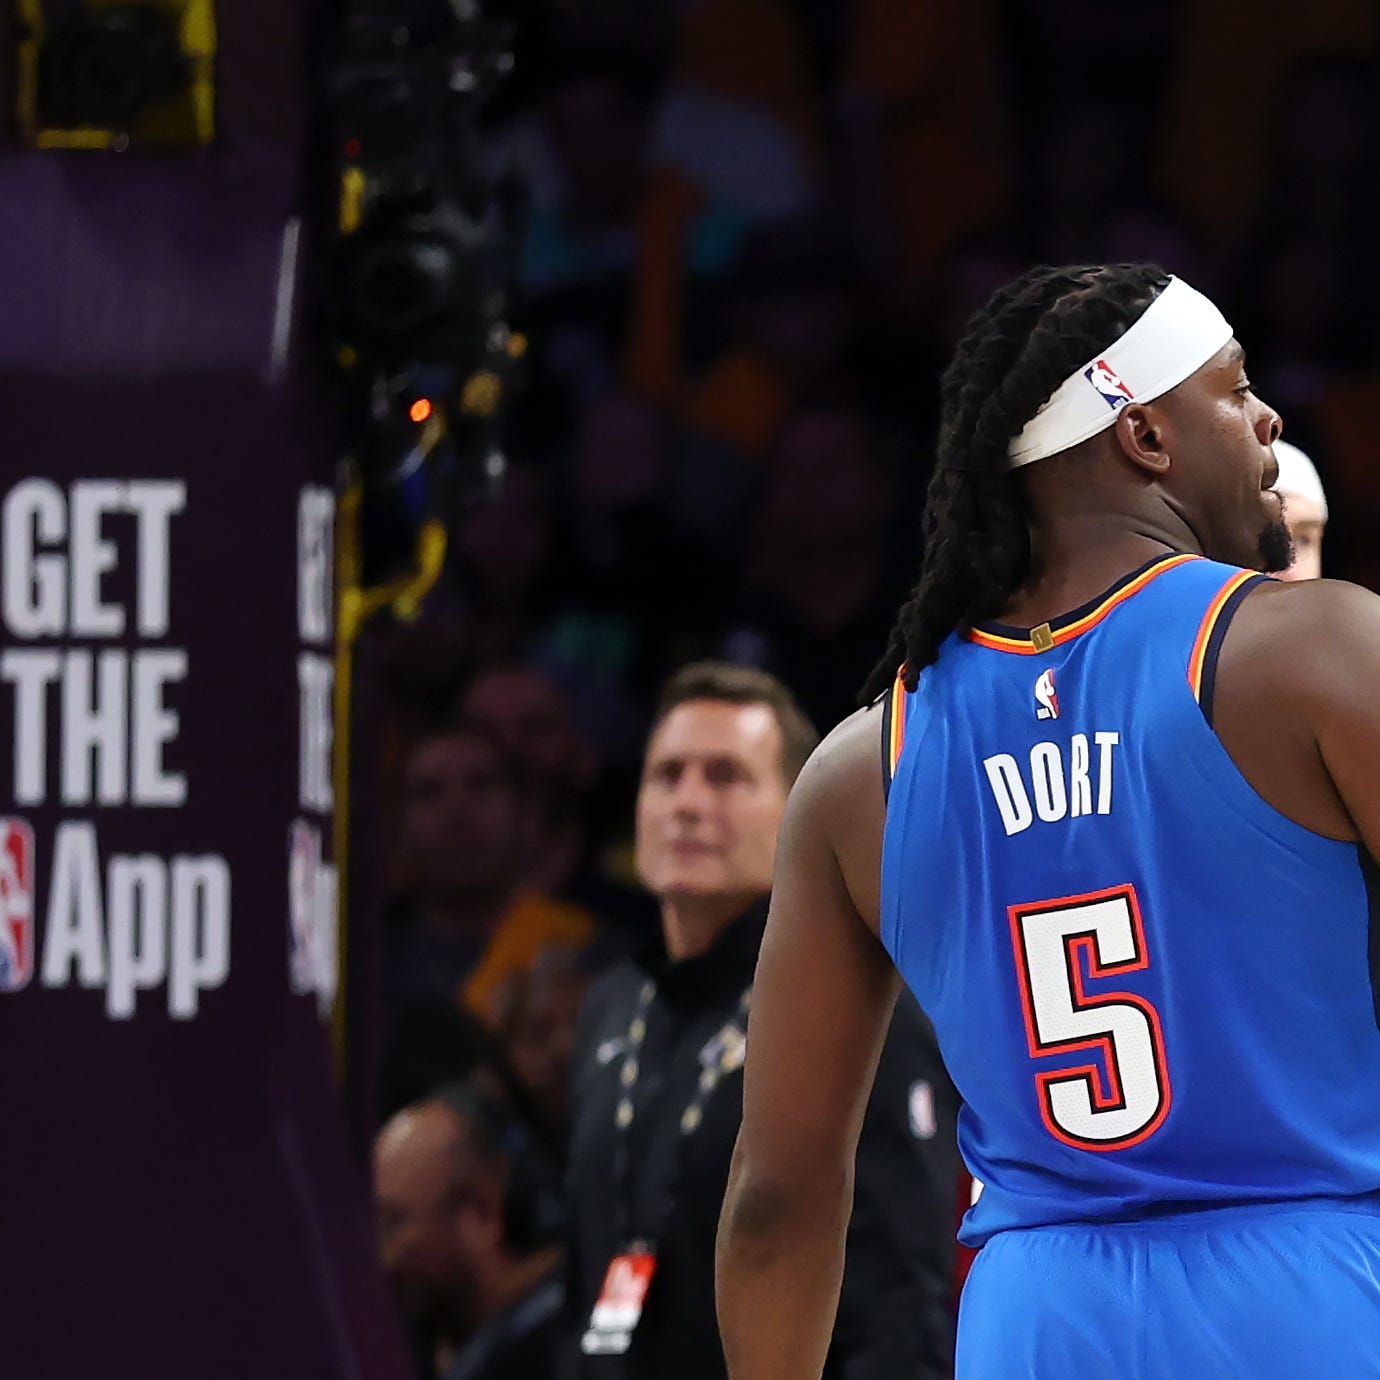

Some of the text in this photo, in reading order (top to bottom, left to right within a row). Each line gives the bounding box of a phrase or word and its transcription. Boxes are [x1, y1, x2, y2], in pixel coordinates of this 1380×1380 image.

[2, 478, 188, 639] GET
[2, 648, 189, 807] THE
[983, 731, 1119, 836] DORT
[41, 820, 232, 1020] App
[1006, 882, 1174, 1152] 5
